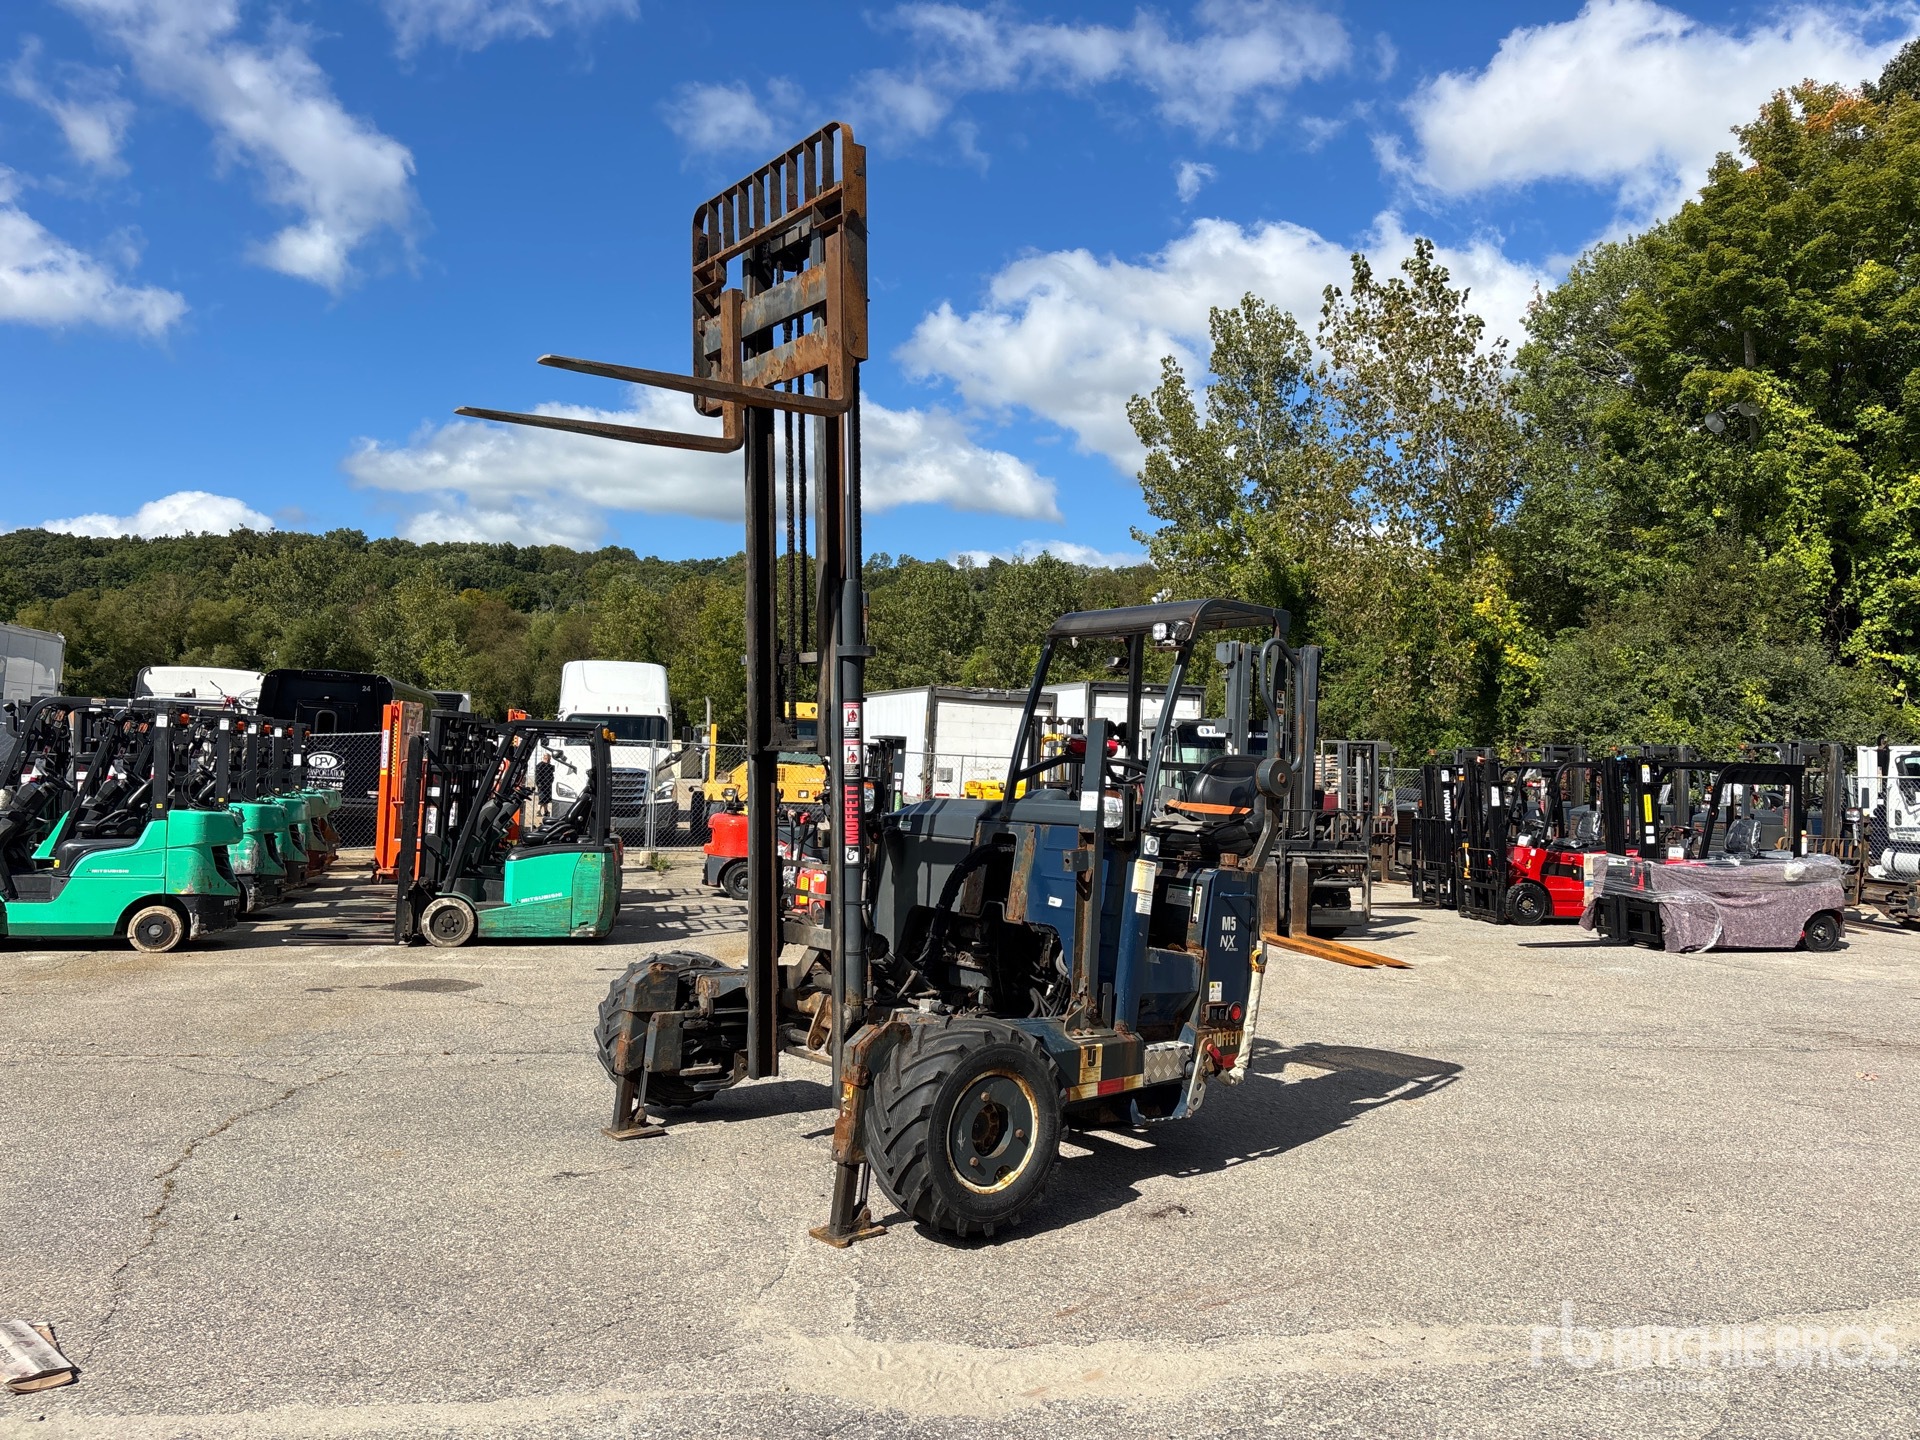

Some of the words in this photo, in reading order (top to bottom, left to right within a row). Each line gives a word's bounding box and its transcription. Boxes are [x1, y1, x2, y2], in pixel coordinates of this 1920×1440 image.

[315, 757, 333, 767] DPV
[845, 784, 859, 845] MOFFETT
[520, 892, 563, 903] MITSUBISHI
[1221, 916, 1237, 931] M5
[1220, 934, 1236, 951] NX
